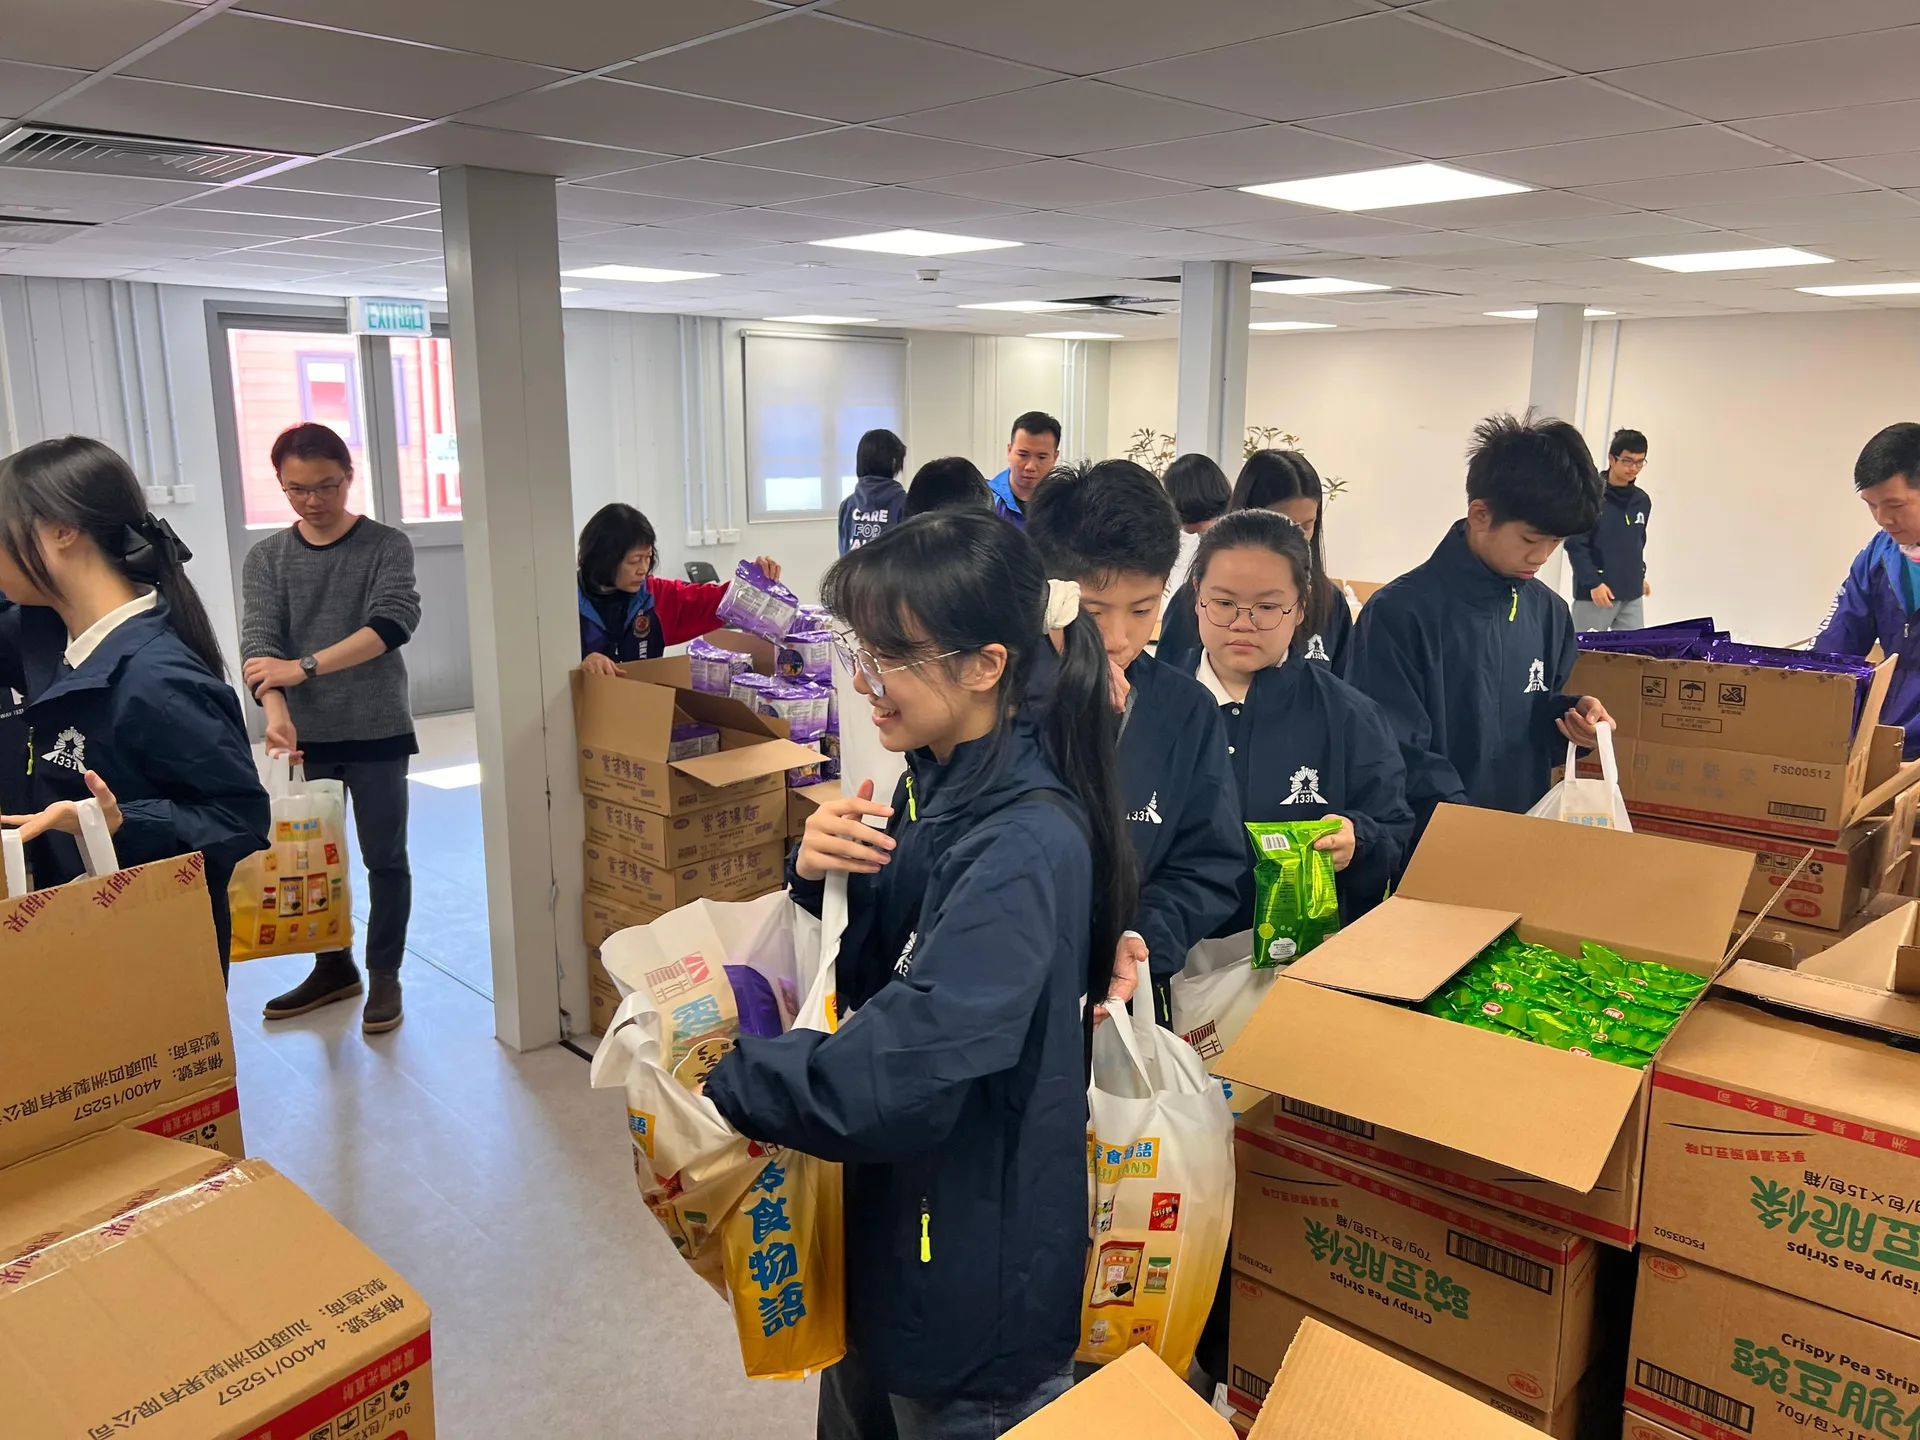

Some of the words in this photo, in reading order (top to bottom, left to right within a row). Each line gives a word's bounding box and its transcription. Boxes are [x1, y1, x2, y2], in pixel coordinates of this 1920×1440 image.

[367, 303, 397, 329] EXIT
[398, 303, 424, 330] 出口
[852, 508, 888, 523] CARE
[53, 754, 78, 771] 1331
[1773, 763, 1832, 780] FSC00512
[1295, 794, 1314, 804] 1331
[0, 1054, 158, 1127] 汕頭四洲製果有限公
[73, 1078, 161, 1121] 4400/15257
[1653, 1226, 1706, 1250] FSC03502
[1786, 1241, 1839, 1268] Strips
[1303, 1216, 1471, 1320] 豌豆脆條
[1843, 1261, 1876, 1281] Pea
[1329, 1271, 1364, 1295] Strips
[1880, 1270, 1920, 1295] ispy
[1367, 1288, 1389, 1306] Pea
[1392, 1299, 1433, 1325] Crispy
[216, 1337, 327, 1406] 4400/15257
[1781, 1333, 1835, 1363] Crispy
[1839, 1355, 1870, 1376] Pea
[1875, 1368, 1920, 1396] Strip
[1730, 1337, 1920, 1440] 豌豆脆
